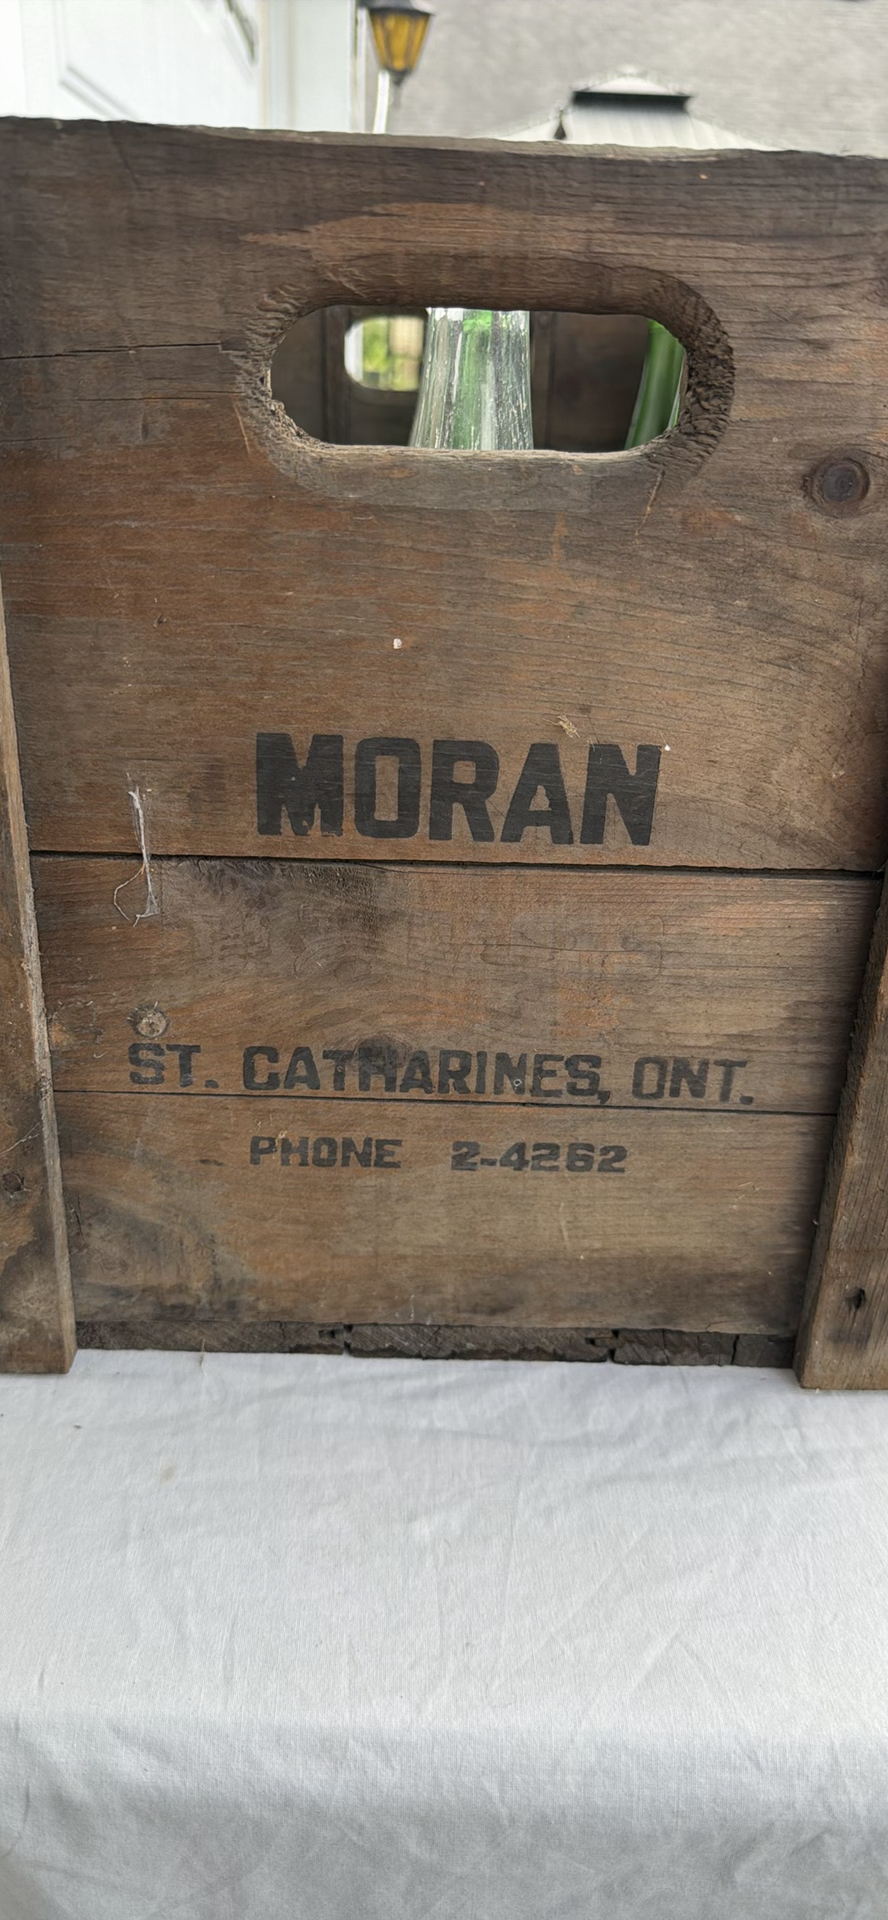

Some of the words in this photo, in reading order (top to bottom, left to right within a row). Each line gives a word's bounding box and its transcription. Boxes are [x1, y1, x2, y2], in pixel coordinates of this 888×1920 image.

[257, 733, 661, 846] MORAN
[129, 1043, 219, 1089] ST.
[243, 1045, 611, 1104] CATHARINES,
[632, 1056, 755, 1105] ONT.
[249, 1135, 402, 1168] PHONE
[451, 1141, 628, 1173] 2-4262
